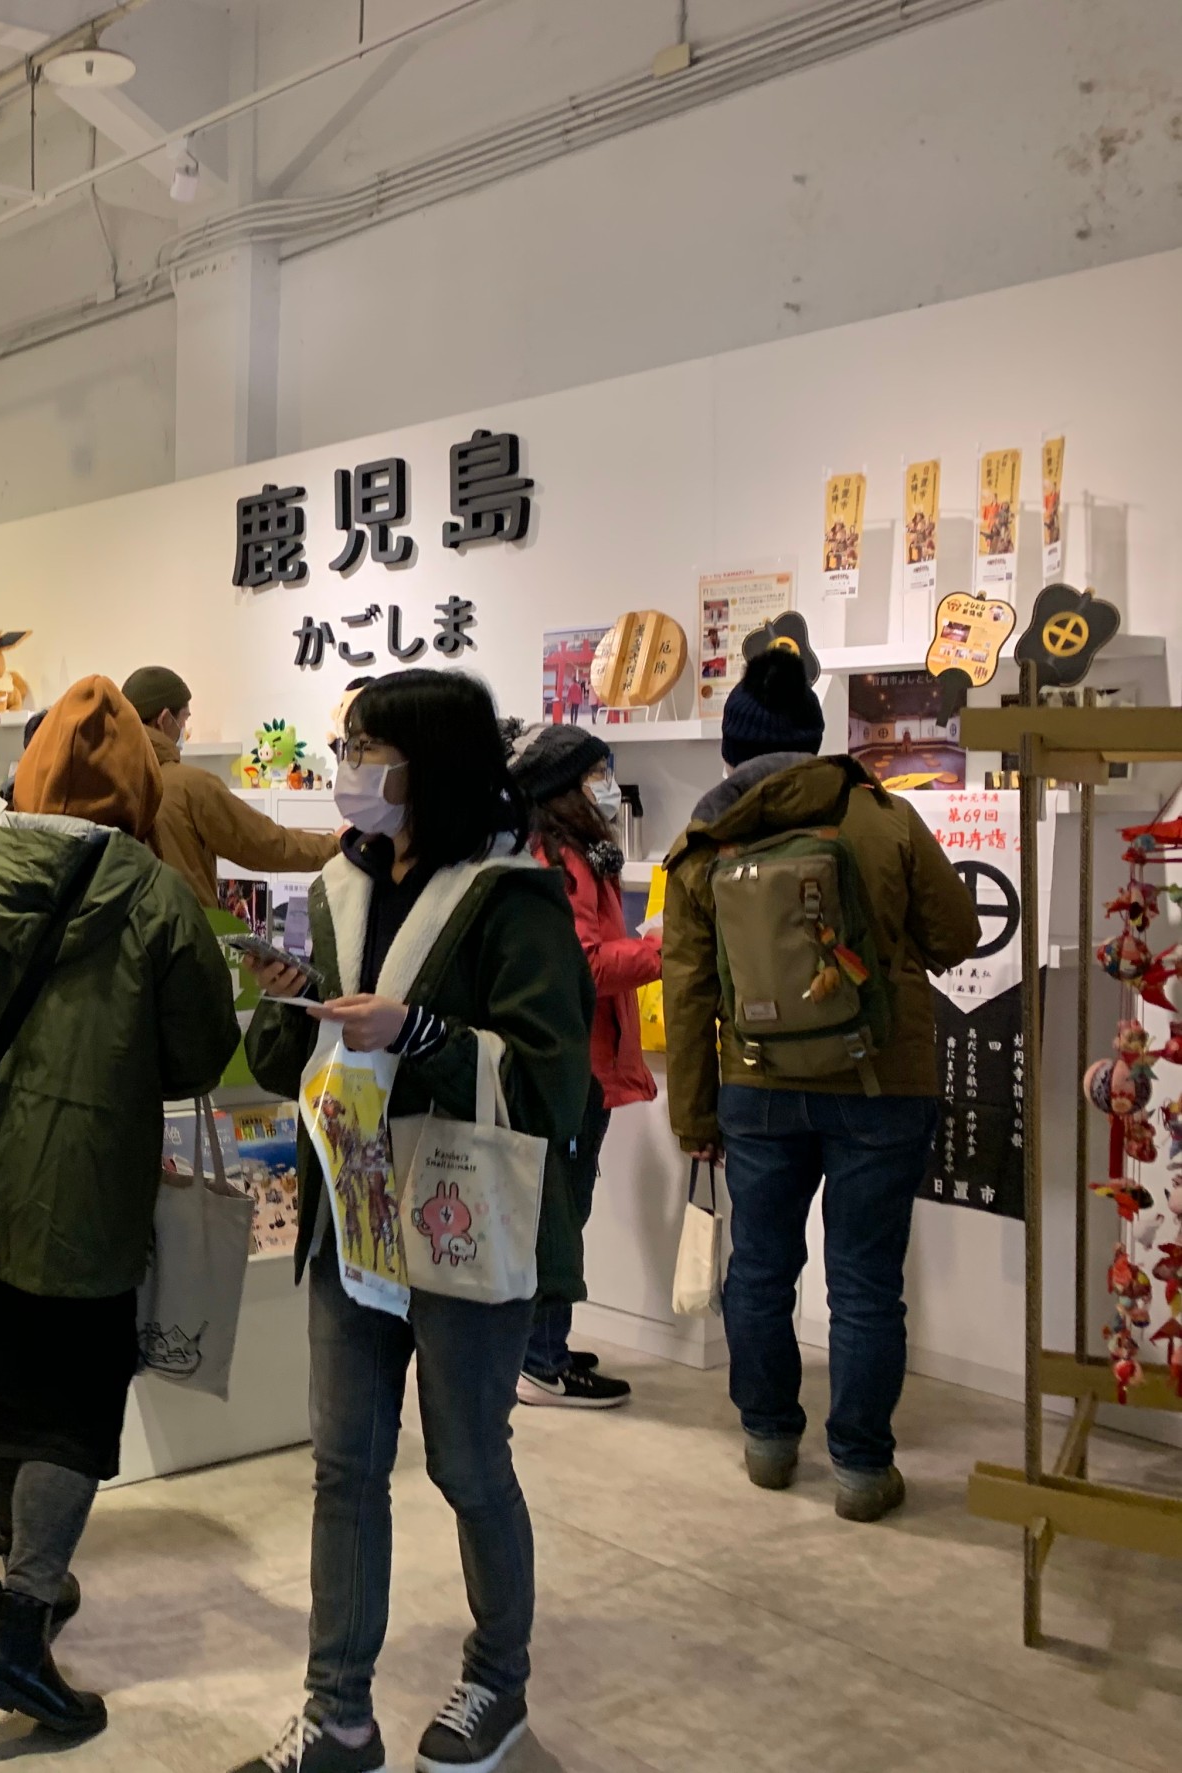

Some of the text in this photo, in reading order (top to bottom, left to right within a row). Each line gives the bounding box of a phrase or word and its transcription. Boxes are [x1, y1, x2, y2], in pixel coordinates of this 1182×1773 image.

[232, 429, 535, 587] 鹿児島
[293, 596, 474, 666] かごしま
[948, 808, 999, 823] 第69回
[988, 1041, 1002, 1051] 四
[934, 1178, 996, 1204] 日置市
